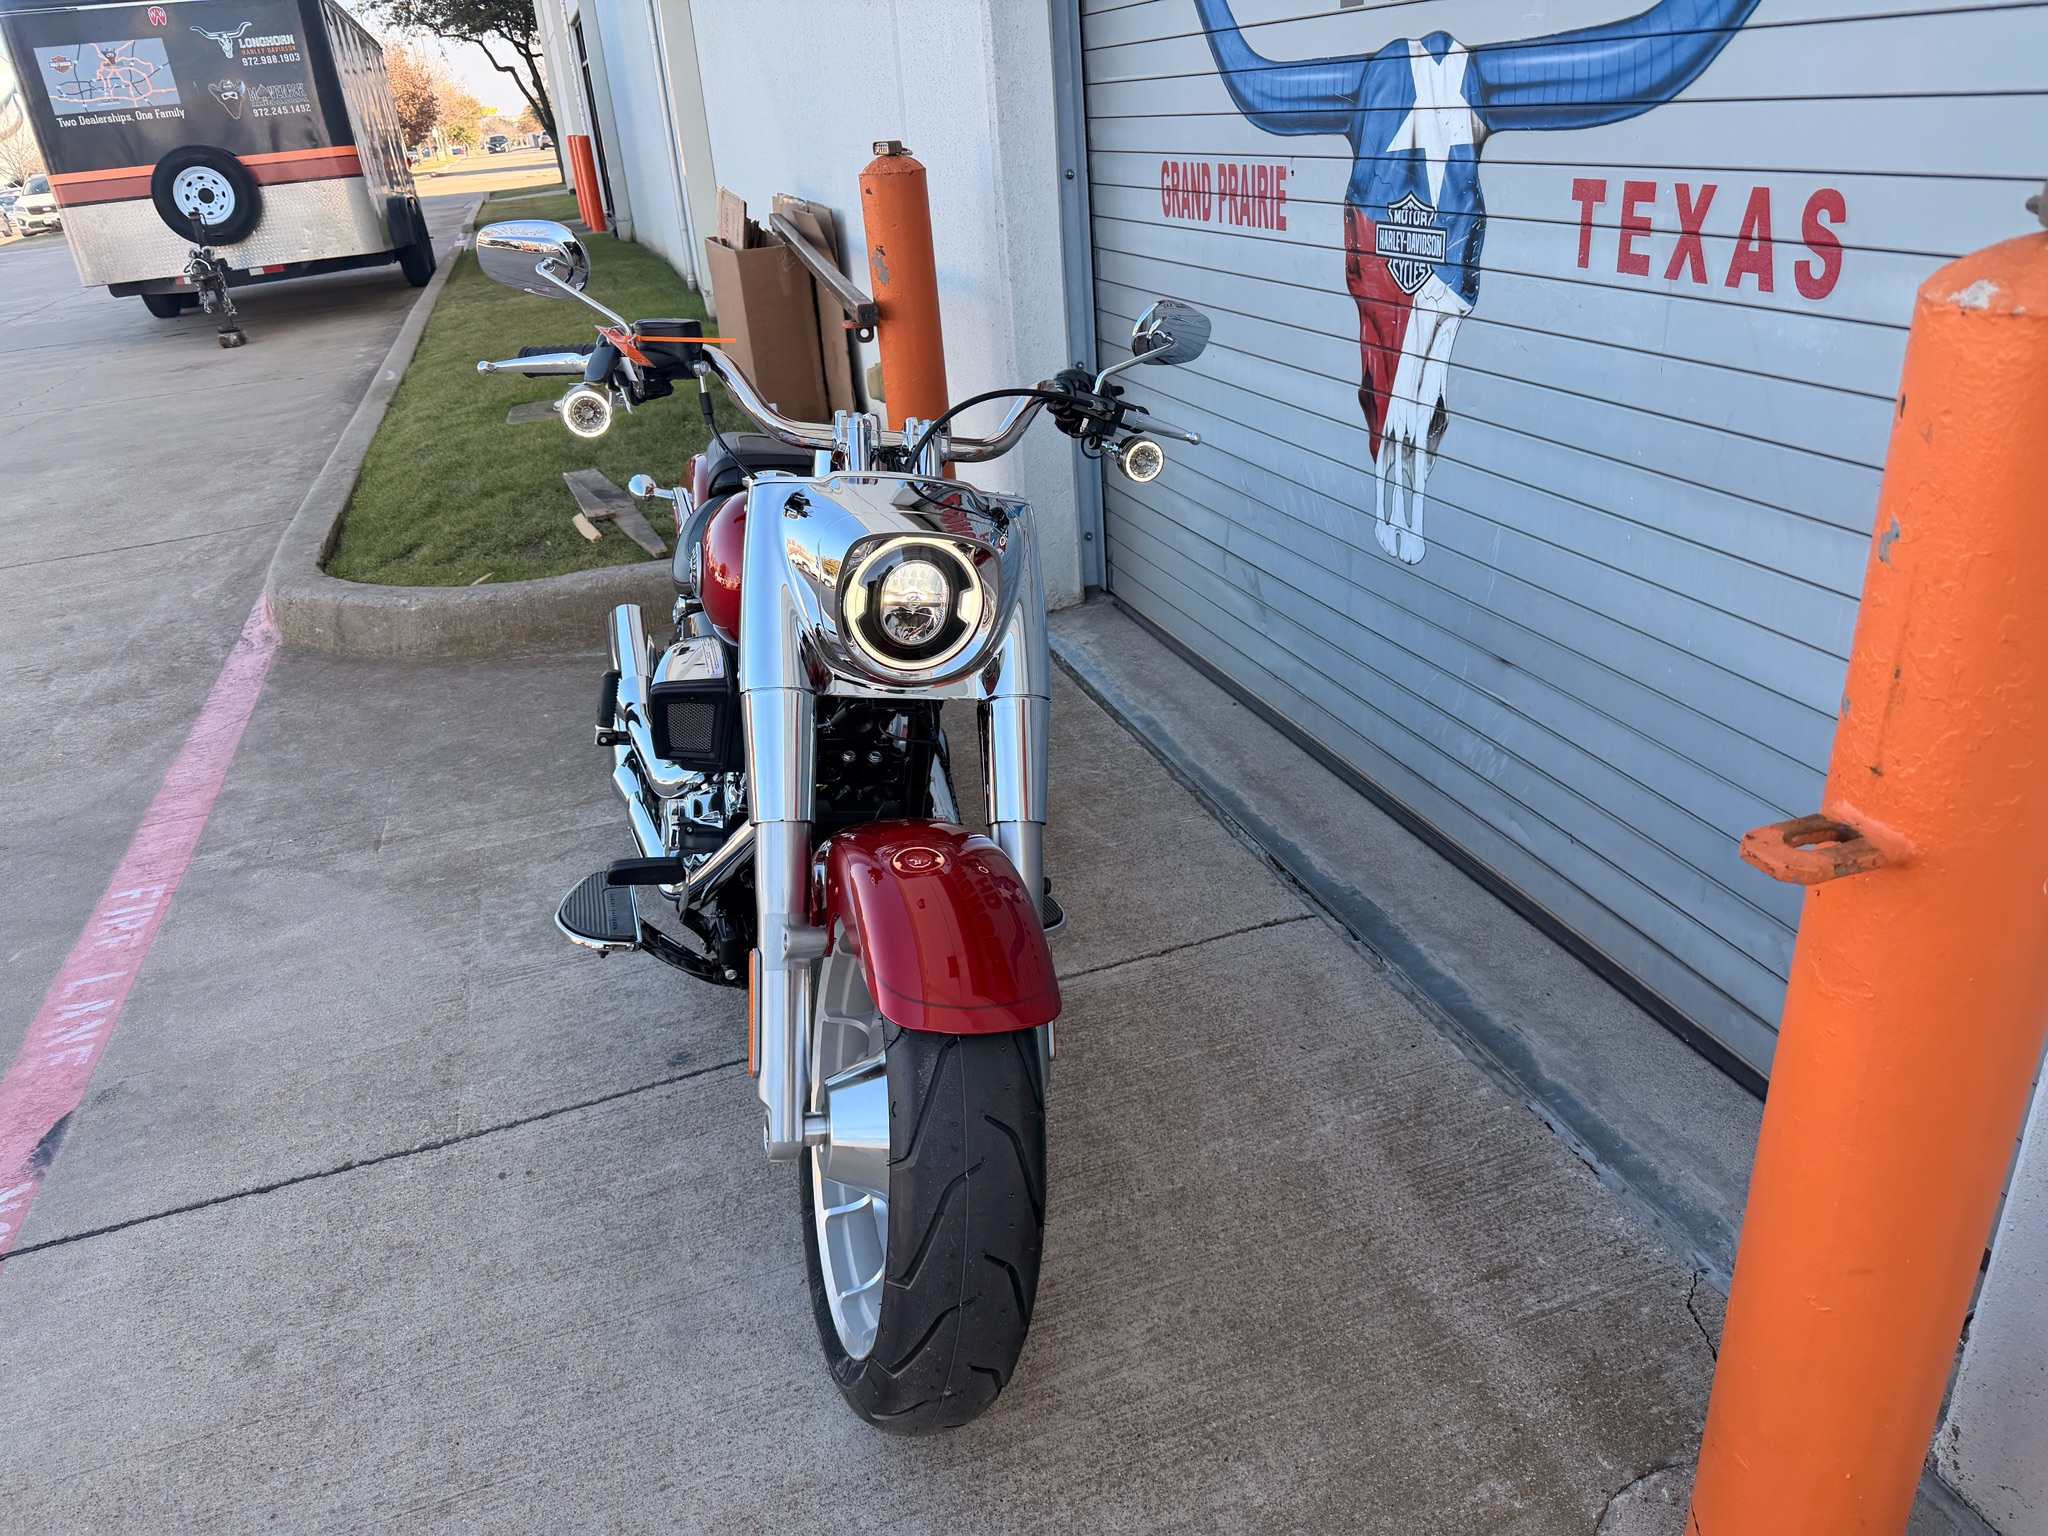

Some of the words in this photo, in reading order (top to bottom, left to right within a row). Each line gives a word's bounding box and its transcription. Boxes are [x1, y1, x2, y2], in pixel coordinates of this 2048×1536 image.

[238, 34, 295, 49] LONGHORN
[241, 48, 266, 56] HARLEY
[267, 45, 297, 53] DAVIDSON
[242, 53, 301, 66] 972.988.1903
[56, 117, 77, 128] Two
[80, 112, 135, 126] Dealerships,
[135, 110, 153, 121] One
[154, 107, 185, 120] Family
[252, 104, 311, 117] 972.245.1492
[1161, 160, 1211, 222] GRAND
[1217, 163, 1287, 231] PRAIRIE
[1393, 209, 1428, 226] MOTOR
[1379, 229, 1443, 257] HARLEY-DAVIDSON
[1572, 178, 1847, 300] TEXAS
[1393, 258, 1426, 289] CYCLES
